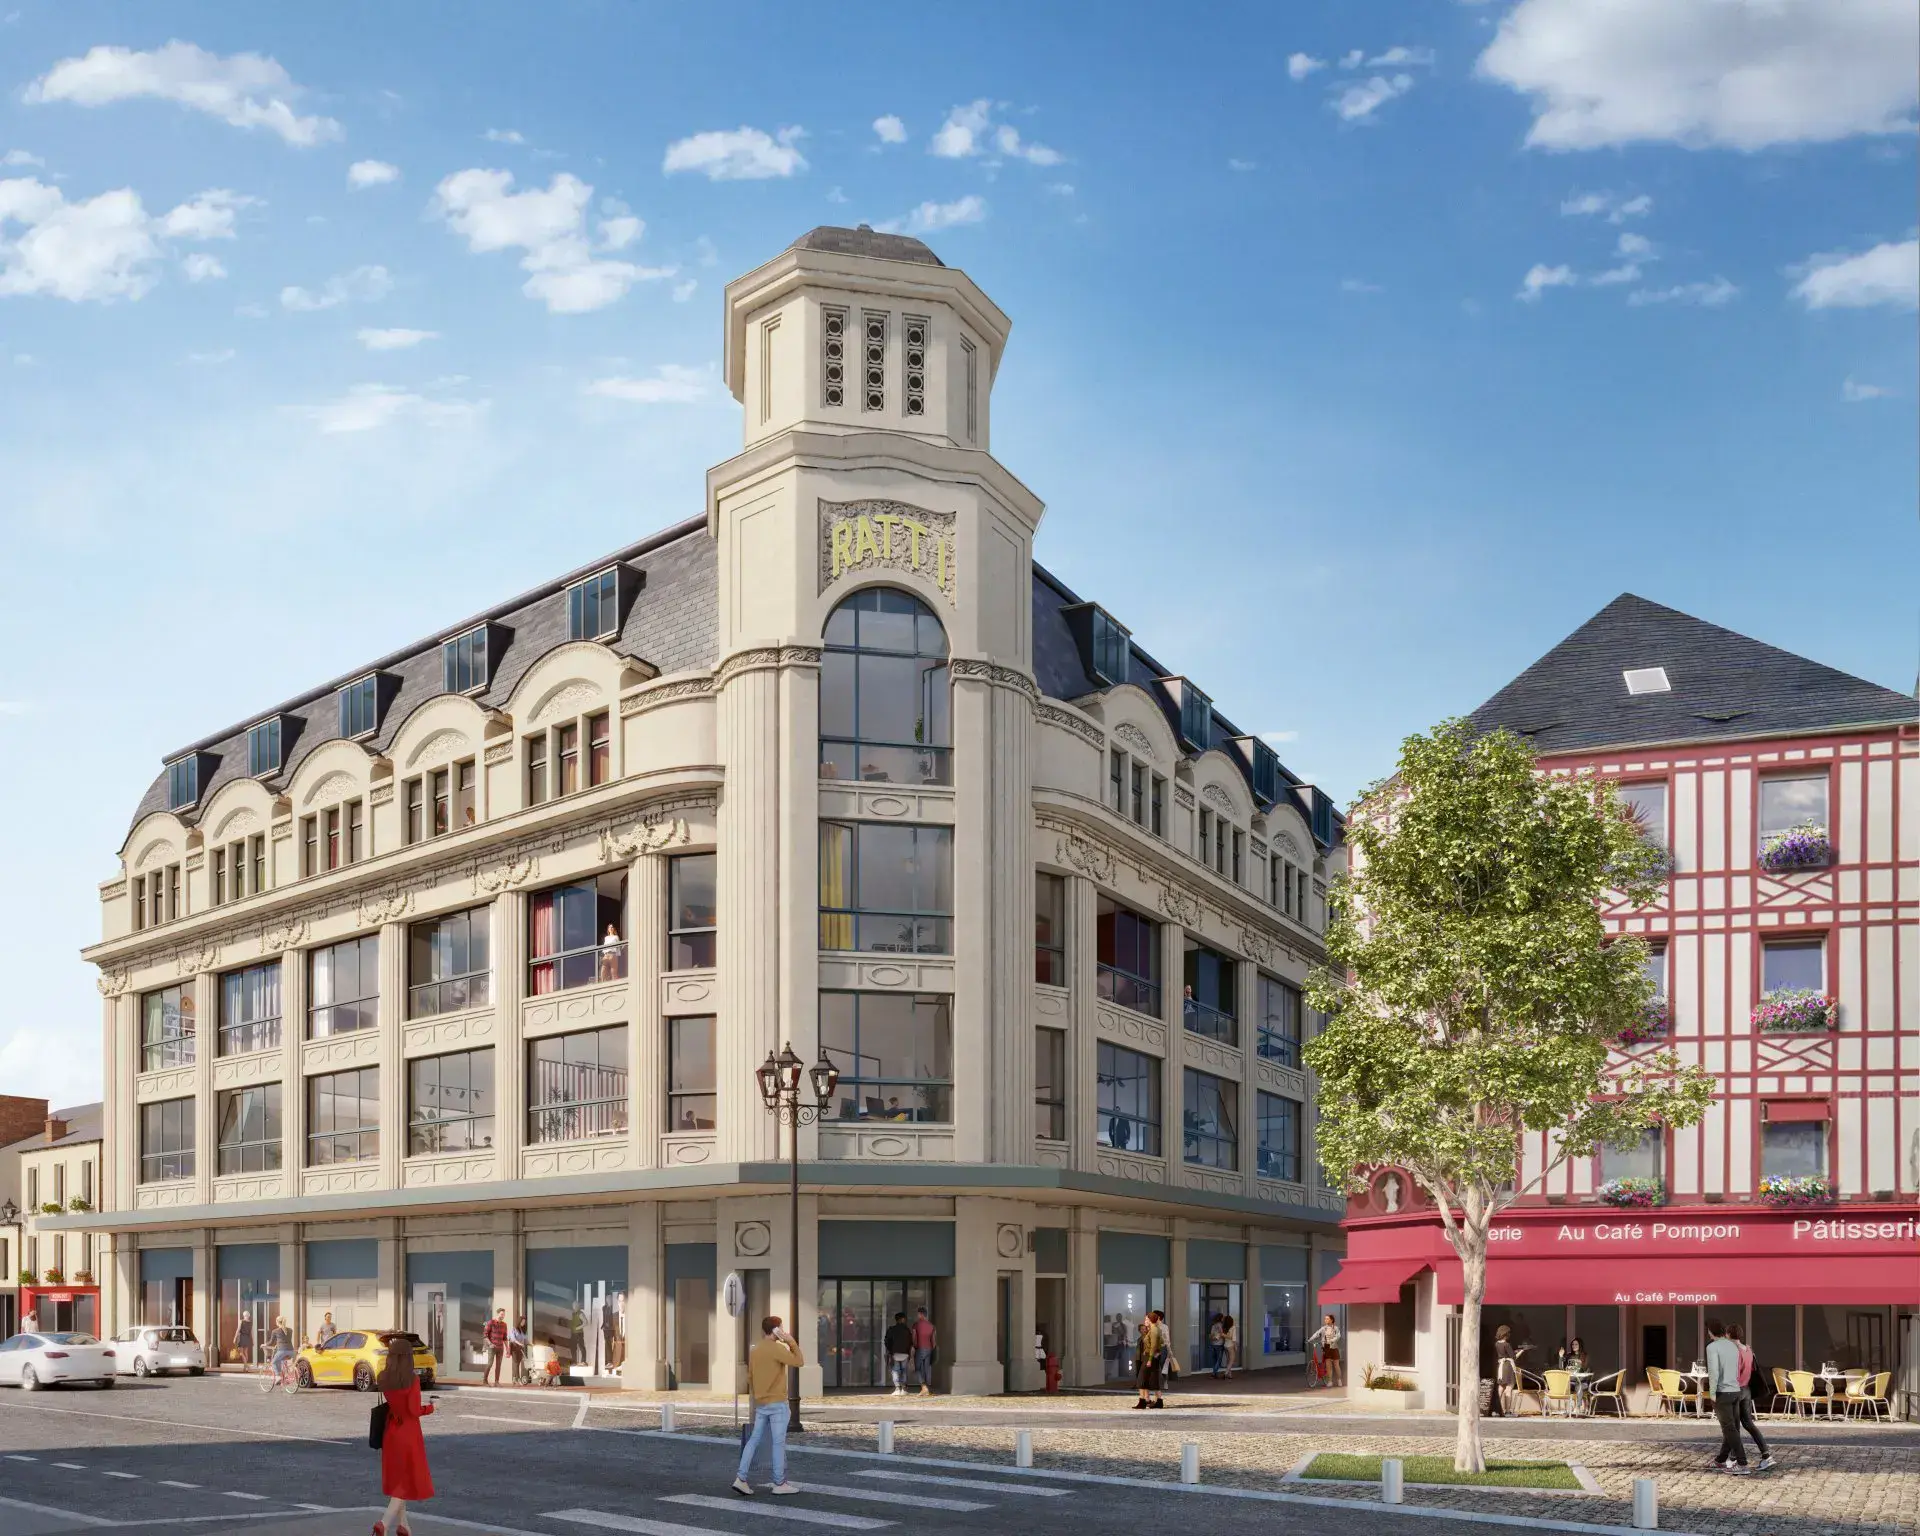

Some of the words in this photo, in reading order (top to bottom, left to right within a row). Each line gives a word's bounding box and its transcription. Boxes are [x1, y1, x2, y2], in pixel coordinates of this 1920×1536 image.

[832, 514, 946, 588] RATTI
[1558, 1225, 1585, 1240] Au
[1594, 1224, 1643, 1240] Café
[1652, 1223, 1741, 1242] Pompon
[1793, 1217, 1920, 1240] Pâtisseri
[1615, 1293, 1630, 1302] Au
[1635, 1292, 1664, 1302] Café
[1668, 1293, 1717, 1304] Pompon
